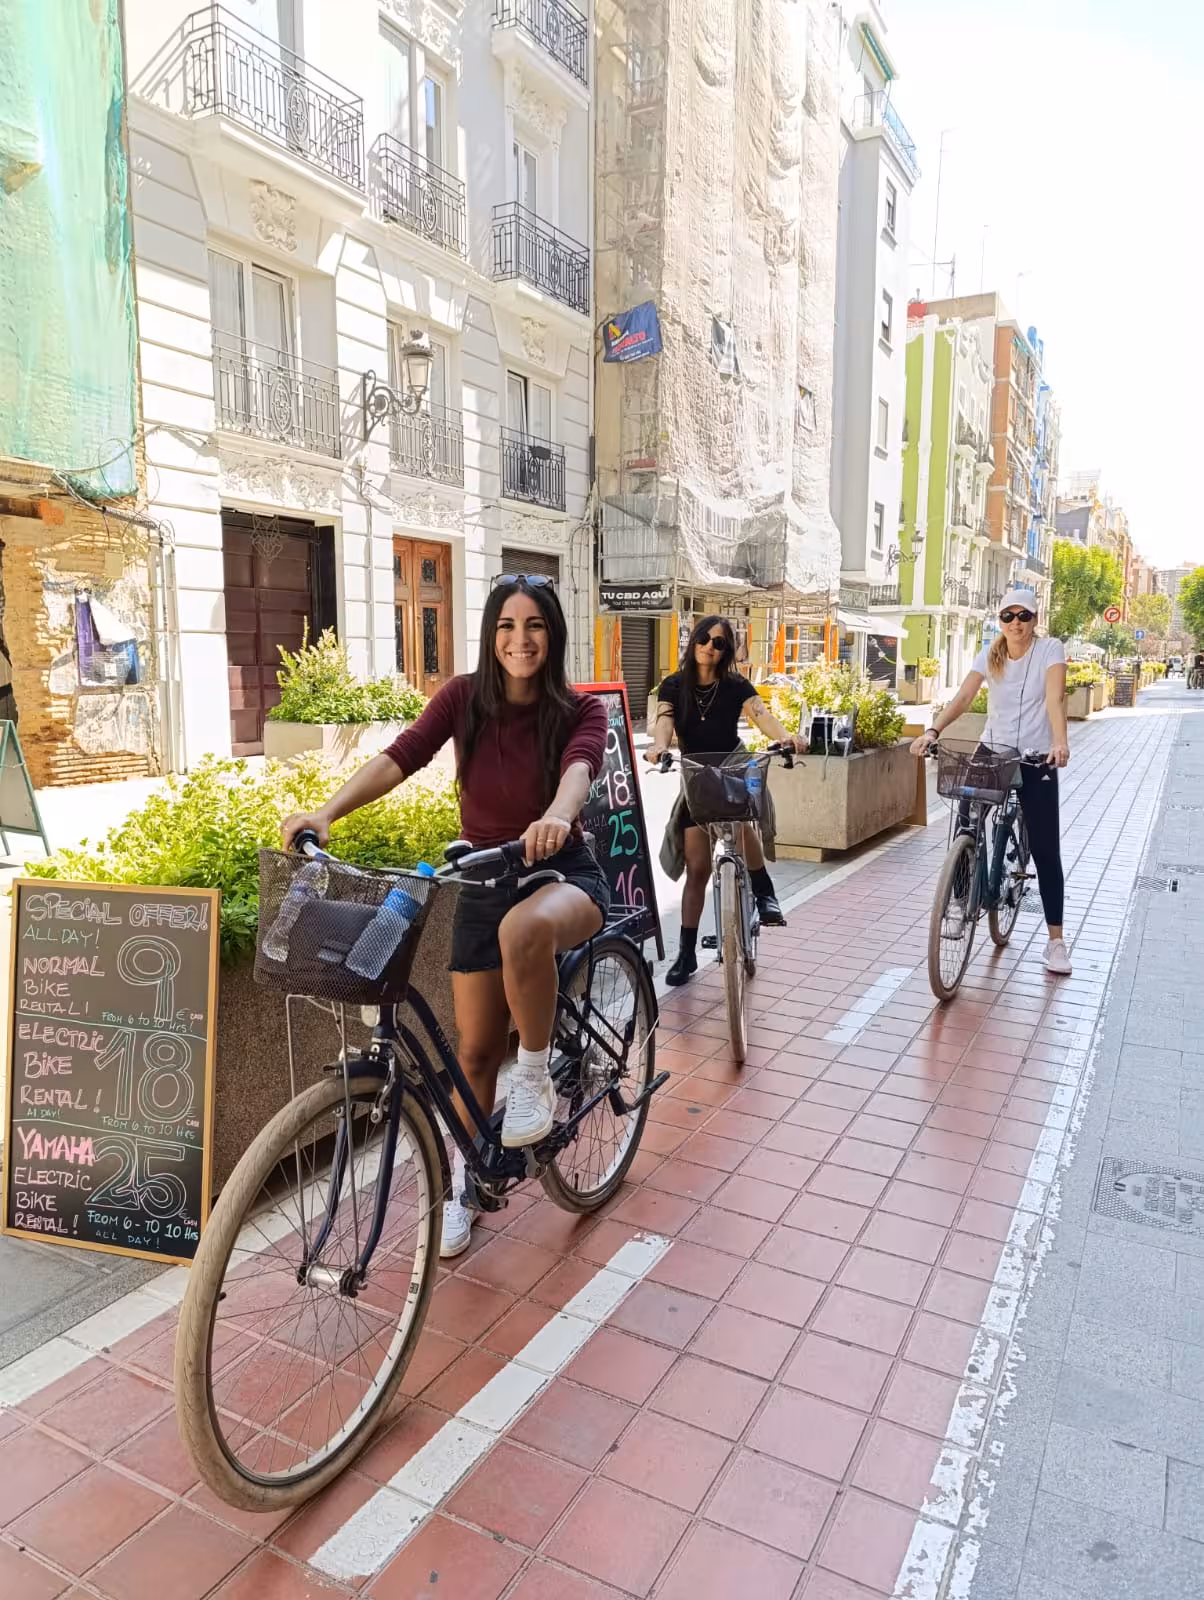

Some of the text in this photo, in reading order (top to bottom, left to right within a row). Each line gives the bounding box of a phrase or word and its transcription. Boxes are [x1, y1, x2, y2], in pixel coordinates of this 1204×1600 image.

[605, 728, 625, 772] 9
[602, 770, 629, 810] 18
[608, 810, 638, 858] 25
[615, 864, 645, 915] 16
[22, 925, 58, 941] ALL
[23, 955, 105, 977] NORMAL
[117, 935, 181, 1022] 9
[127, 1015, 134, 1025] 6
[94, 1029, 195, 1123] 18
[102, 1115, 128, 1129] FROM
[131, 1121, 139, 1131] 6
[159, 1124, 173, 1136] 10
[17, 1126, 96, 1167] YAMAHA
[84, 1135, 187, 1219] 25
[87, 1210, 118, 1226] FROM
[123, 1216, 132, 1230] 6
[145, 1219, 160, 1233] TO
[164, 1223, 181, 1238] 10
[95, 1230, 117, 1240] ALL
